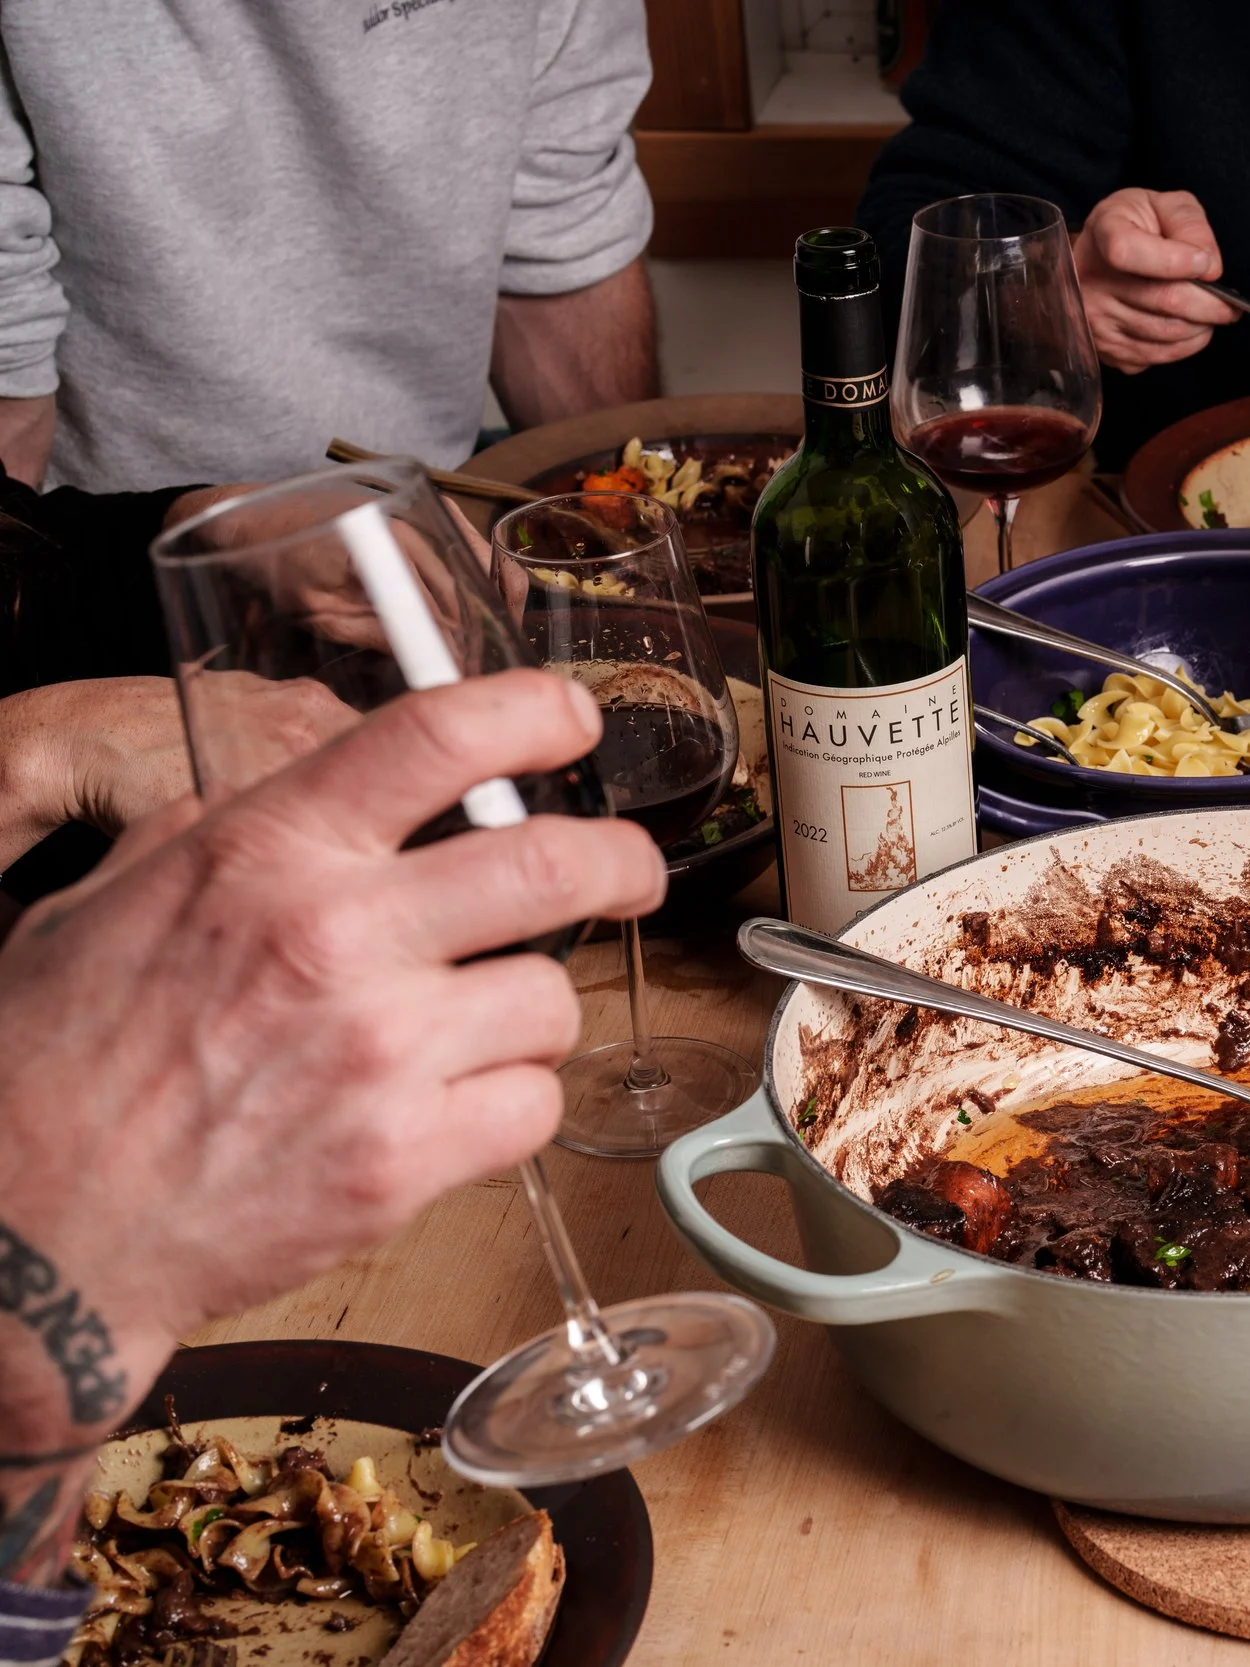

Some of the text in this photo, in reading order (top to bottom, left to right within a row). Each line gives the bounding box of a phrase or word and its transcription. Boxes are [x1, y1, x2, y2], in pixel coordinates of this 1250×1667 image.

[780, 685, 957, 720] DOMAINE
[780, 699, 960, 747] HAUVETTE
[782, 729, 961, 766] Indication Géographique Protégée Alpilles
[858, 770, 892, 779] RED WINE
[793, 820, 829, 843] 2022
